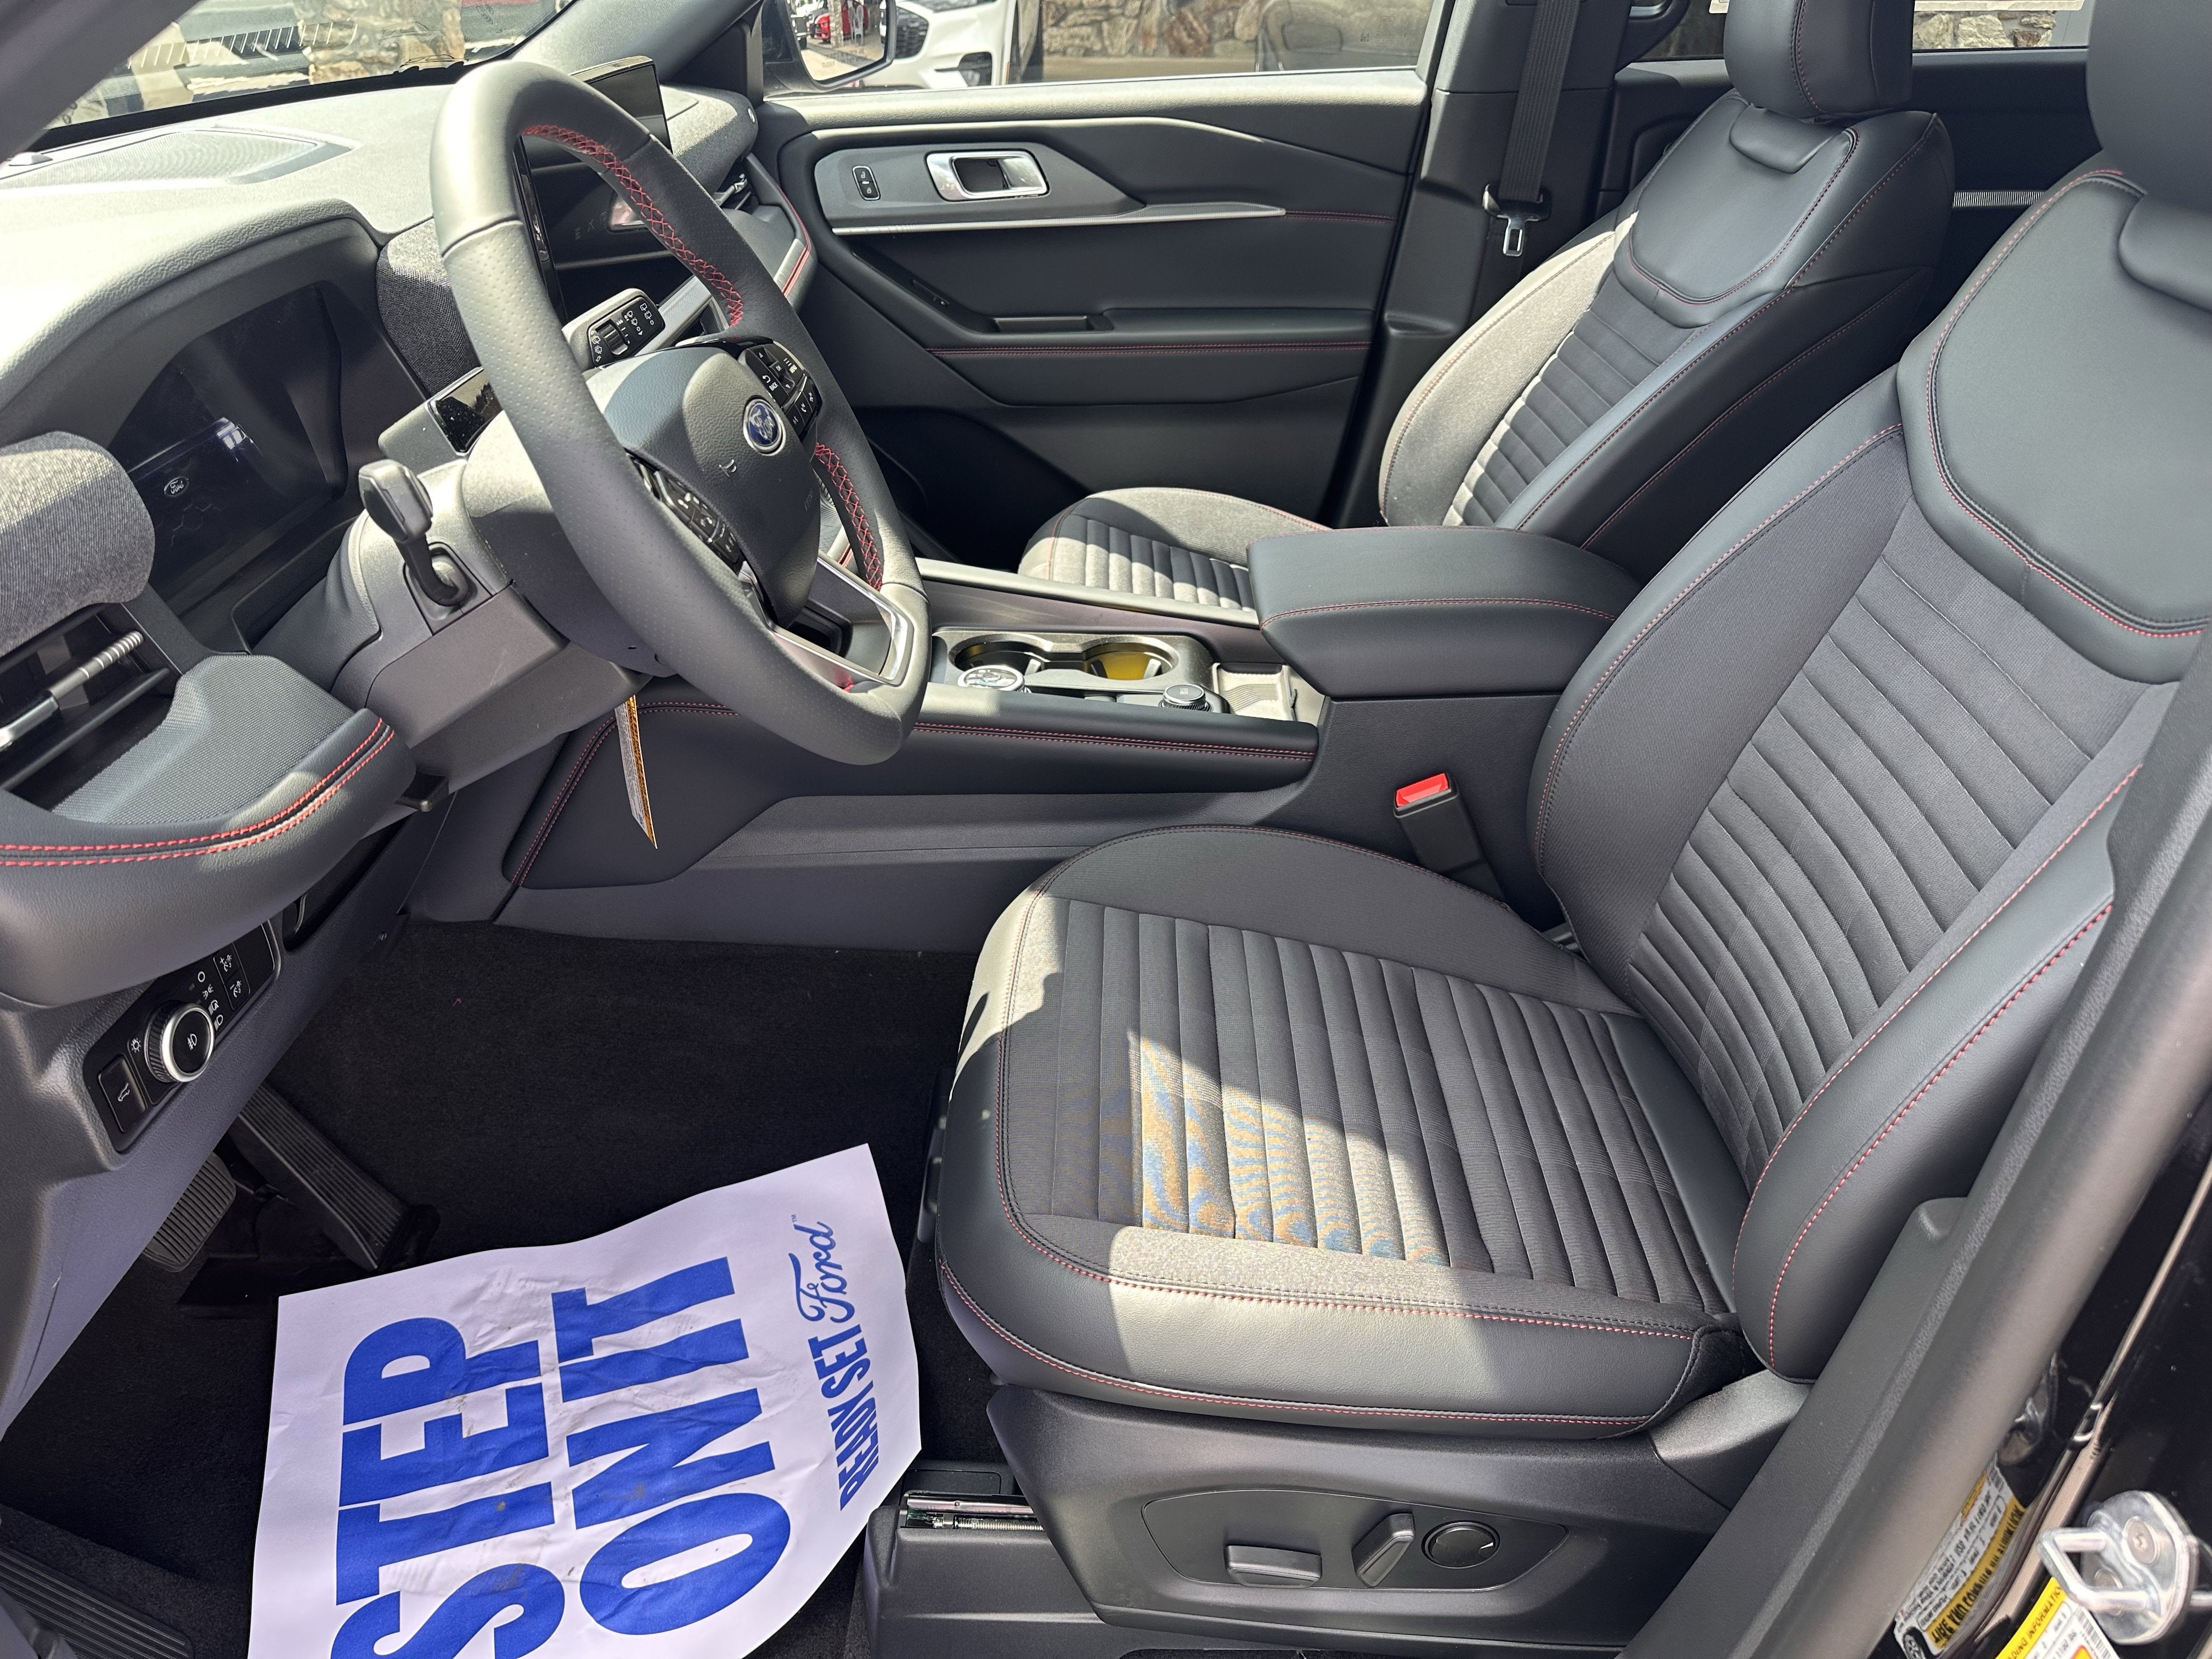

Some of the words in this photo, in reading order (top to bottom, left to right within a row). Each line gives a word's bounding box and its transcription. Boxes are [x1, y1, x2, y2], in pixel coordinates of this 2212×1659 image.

[551, 1256, 749, 1403] IT
[788, 1221, 855, 1323] Ford
[807, 1324, 871, 1399] SET
[330, 1317, 565, 1659] STEP
[566, 1388, 791, 1636] ON
[827, 1380, 879, 1511] READY
